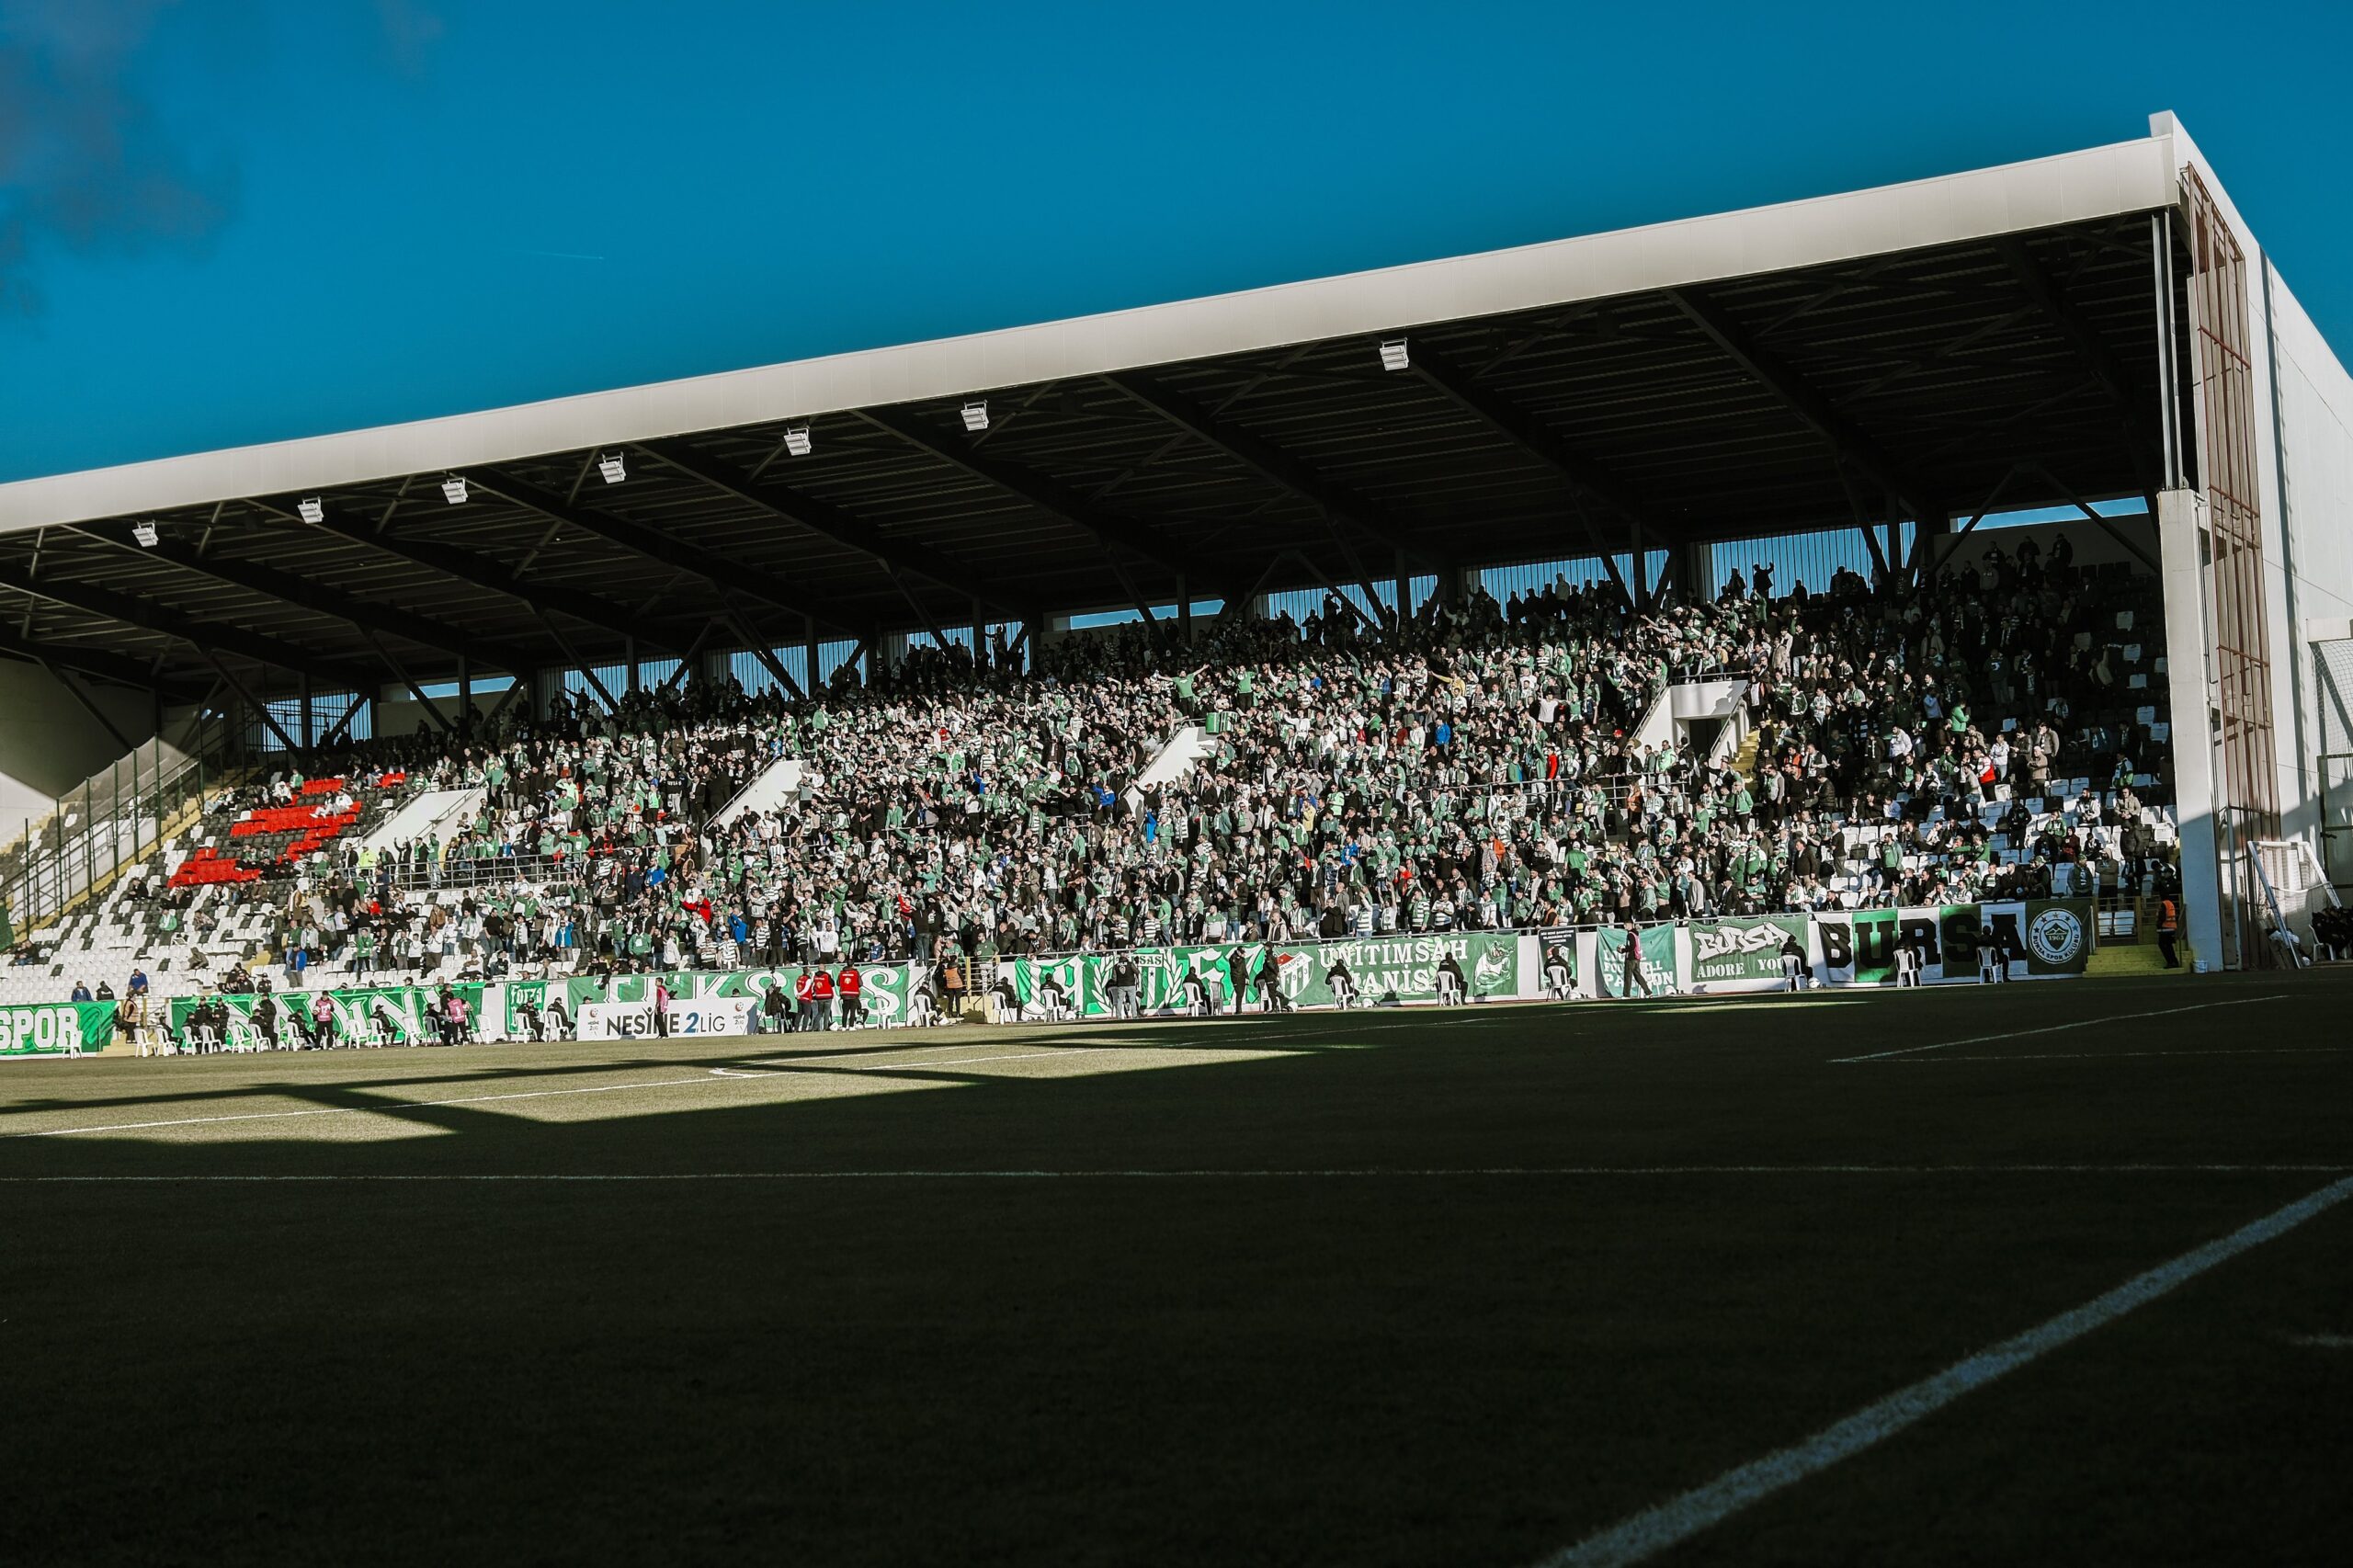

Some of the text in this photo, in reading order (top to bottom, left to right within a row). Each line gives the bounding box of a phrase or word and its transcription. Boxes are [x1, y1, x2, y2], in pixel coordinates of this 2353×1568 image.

[1818, 913, 2028, 970] BURSA
[1351, 964, 1438, 995] ANİS
[1697, 963, 1745, 978] ADORE
